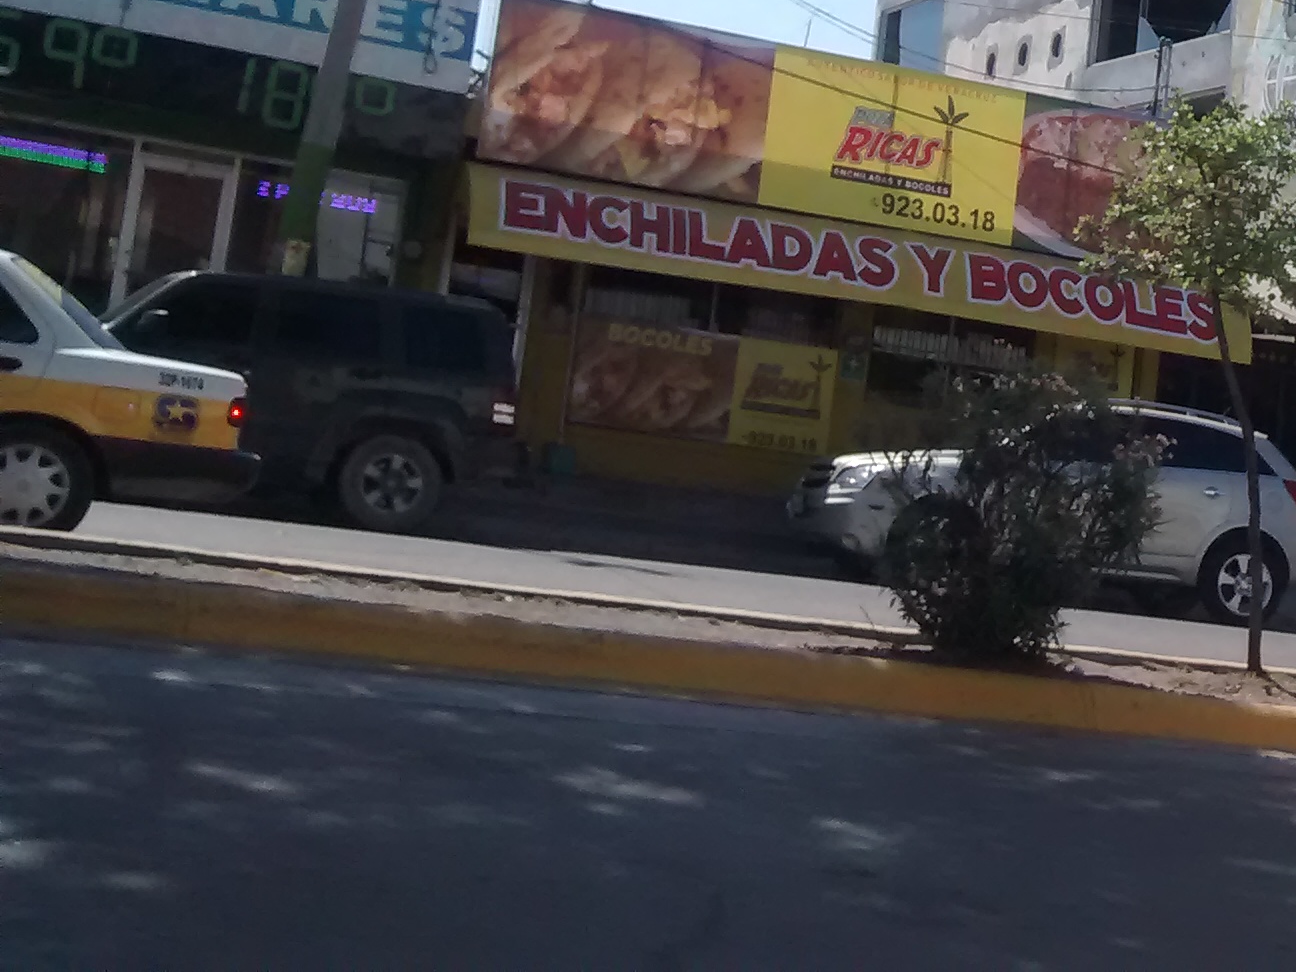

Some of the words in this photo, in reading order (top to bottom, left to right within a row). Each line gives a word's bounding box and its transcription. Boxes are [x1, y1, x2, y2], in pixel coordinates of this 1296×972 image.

[835, 125, 943, 168] RICAS
[833, 167, 894, 187] ENCHILADAS
[896, 178, 903, 187] Y
[905, 180, 949, 196] BOCOLES
[881, 193, 996, 232] 923.03.18
[503, 180, 898, 288] ENCHILADAS
[907, 242, 954, 297] Y
[965, 251, 1218, 343] BOCOLES
[608, 323, 714, 357] BOCOLES
